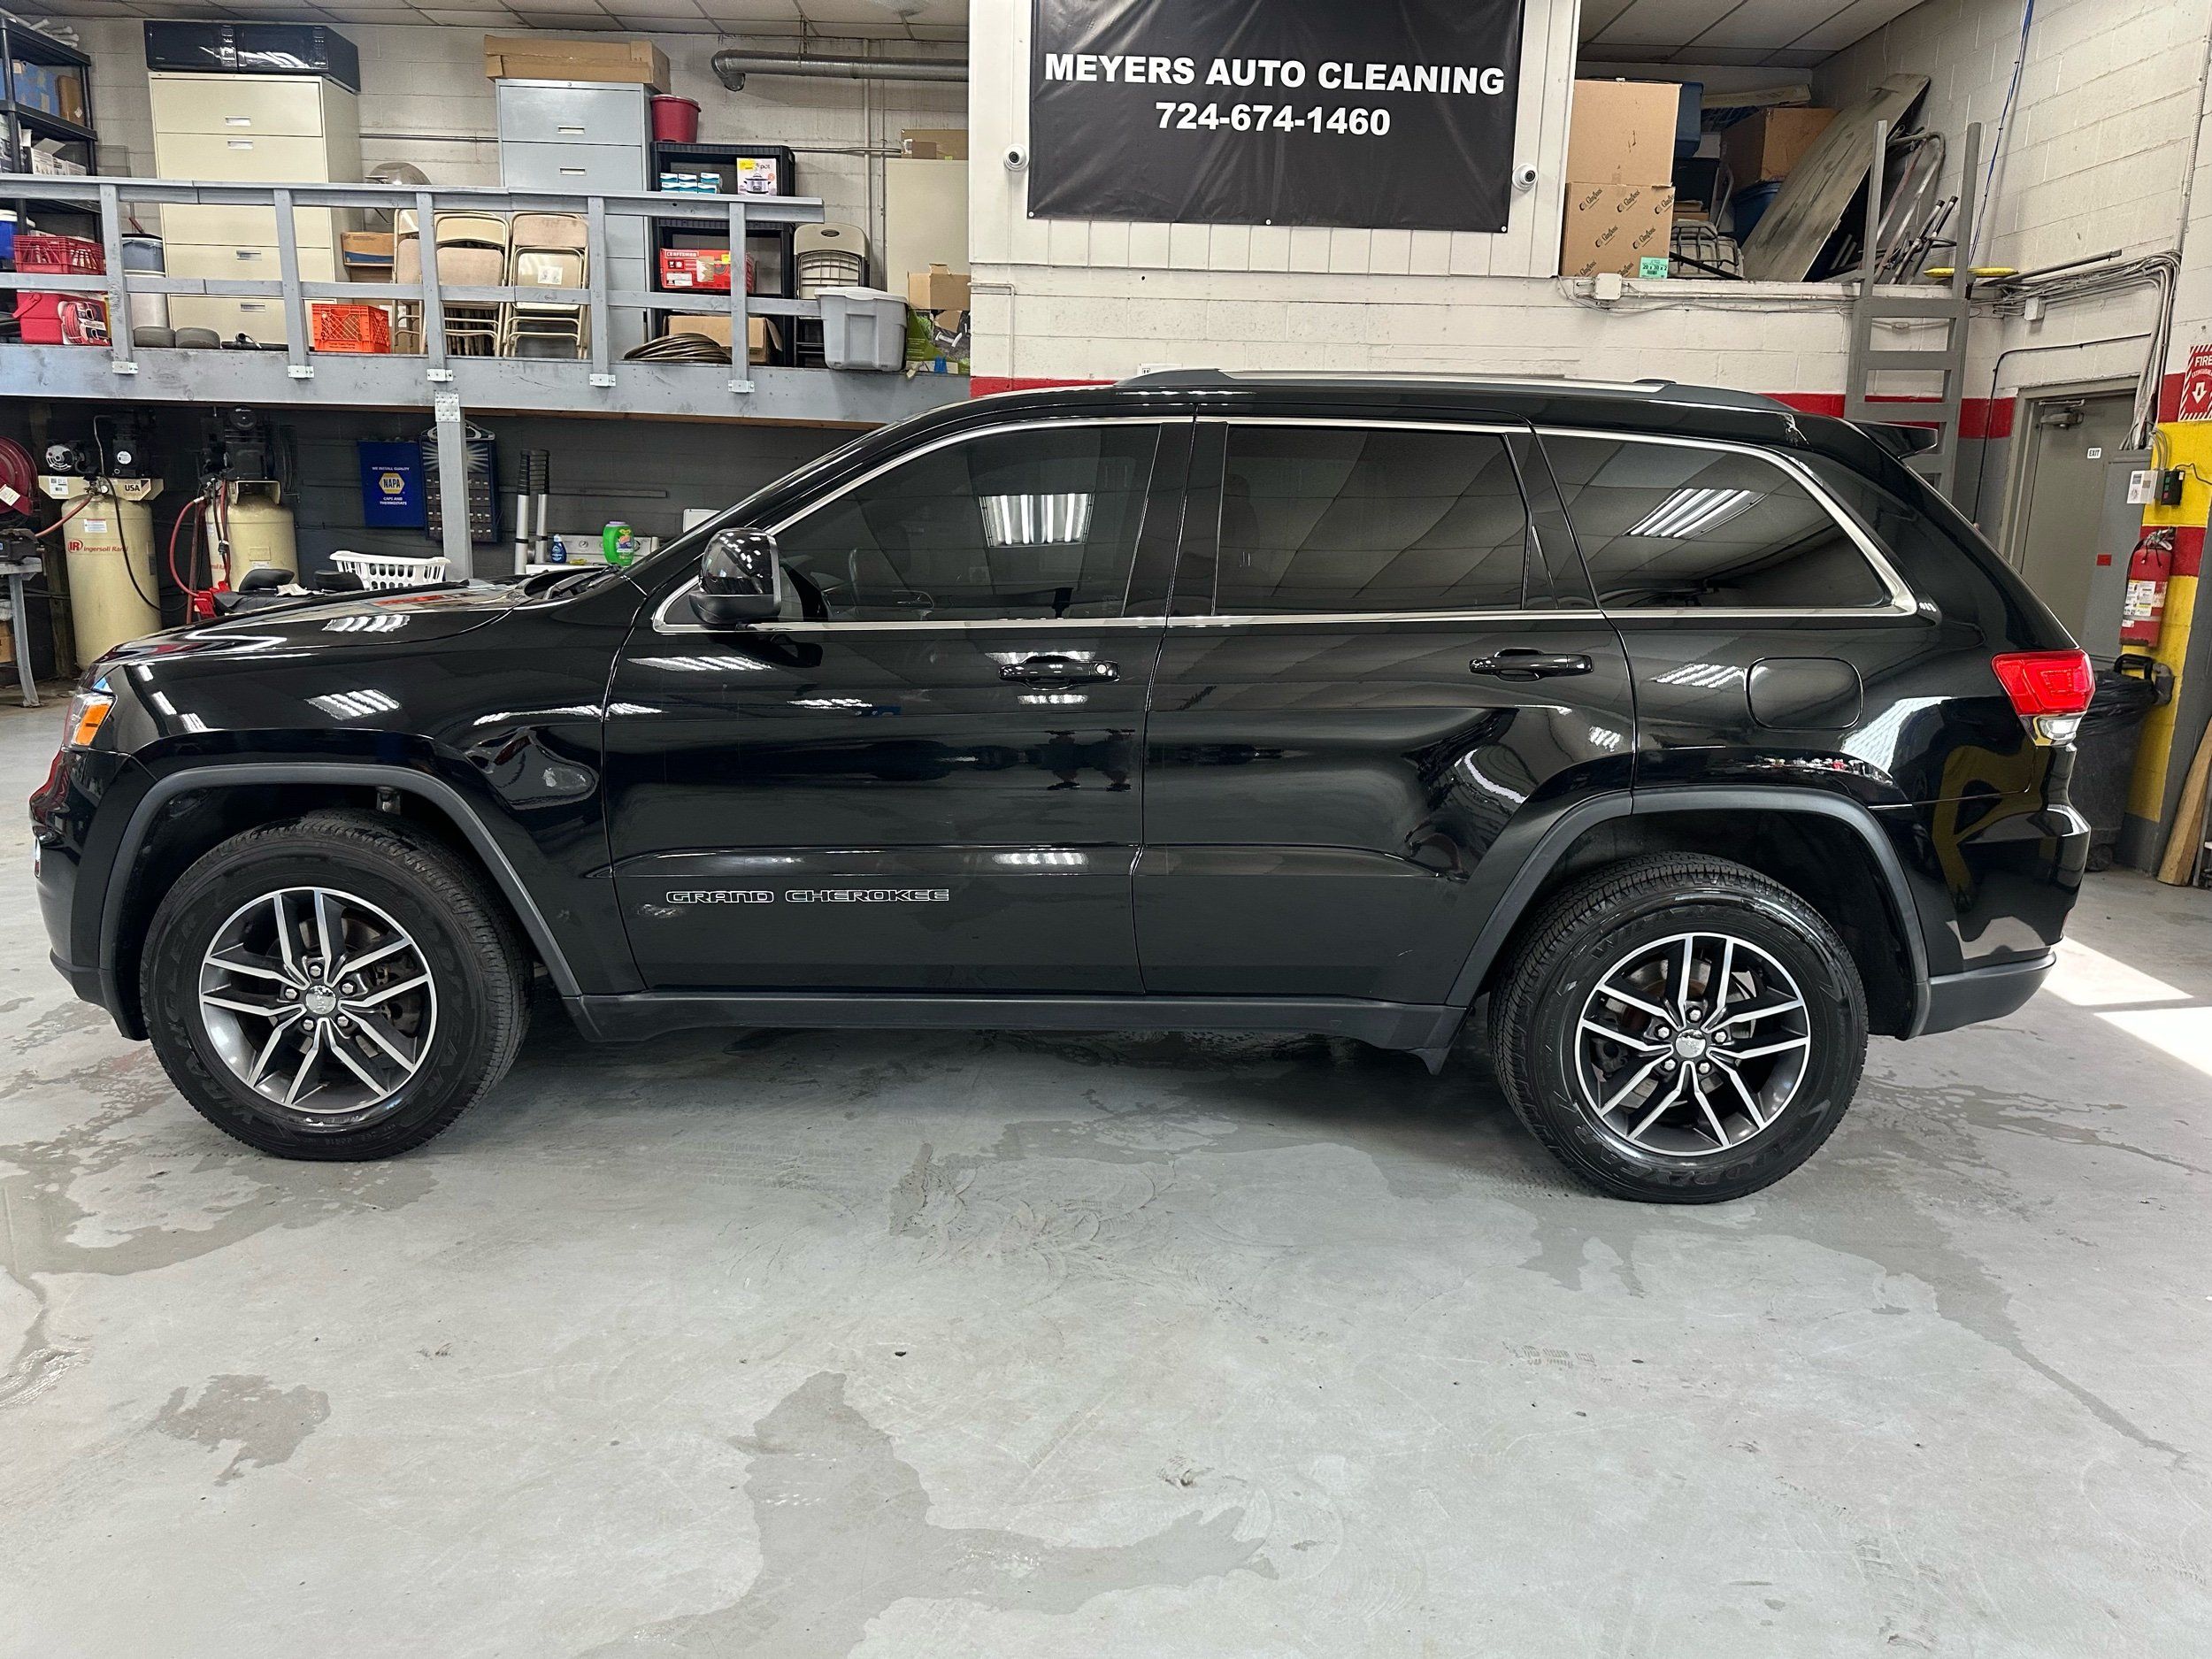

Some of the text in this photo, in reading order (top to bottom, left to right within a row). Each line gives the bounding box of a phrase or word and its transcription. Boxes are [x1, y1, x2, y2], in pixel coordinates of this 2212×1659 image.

[1046, 54, 1503, 94] MEYERS AUTO CLEANING
[1156, 103, 1389, 135] 724-674-1460
[2194, 355, 2212, 367] FIRE
[383, 478, 401, 488] NAPA
[666, 889, 949, 903] GRAND CHEROKEE
